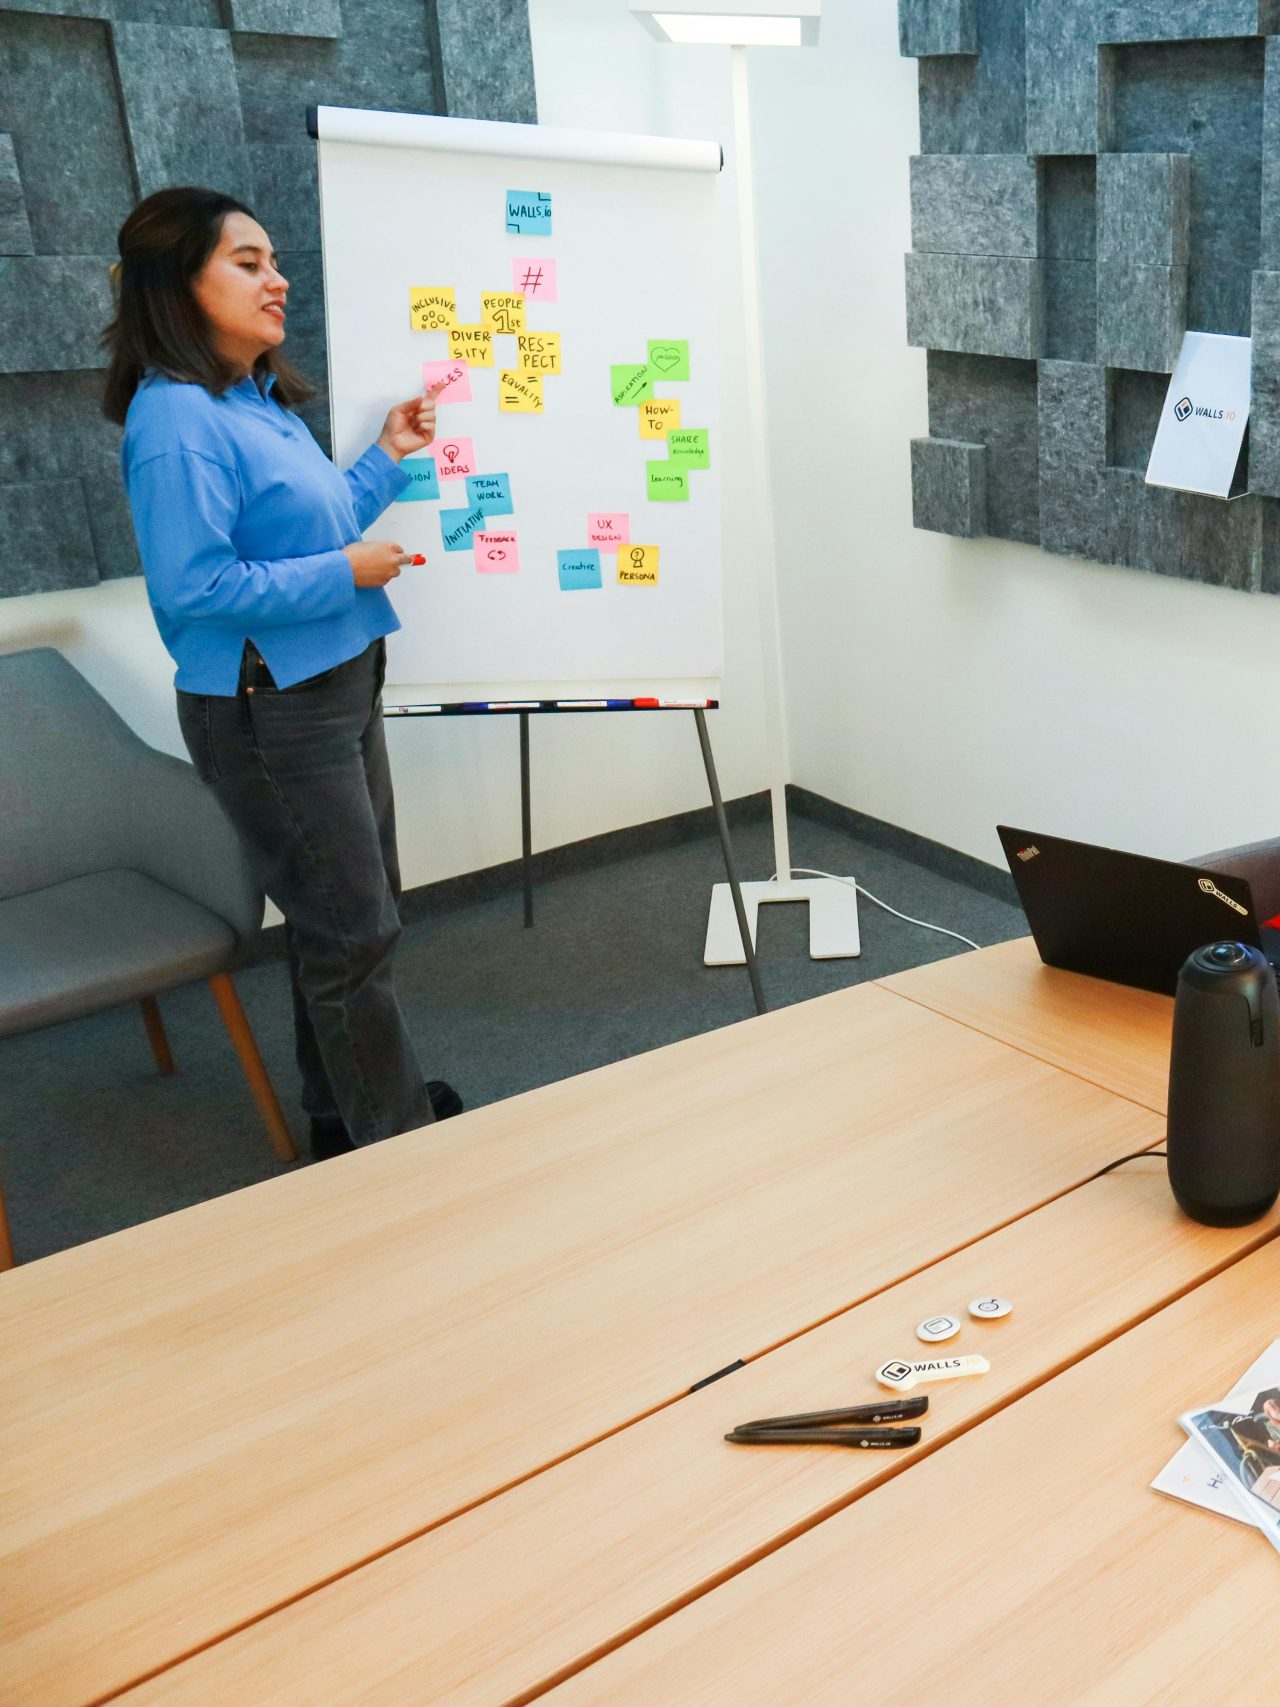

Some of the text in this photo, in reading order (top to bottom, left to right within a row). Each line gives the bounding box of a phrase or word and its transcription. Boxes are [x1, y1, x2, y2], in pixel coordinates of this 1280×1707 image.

[520, 266, 544, 294] #
[411, 296, 457, 313] INCLUSIVE
[483, 297, 523, 310] PEOPLE
[492, 308, 521, 334] 1st
[451, 330, 492, 343] DIVER-
[518, 336, 555, 353] RES-
[453, 347, 488, 360] SITY
[523, 354, 557, 369] PECT
[501, 373, 543, 409] EQUALITY
[614, 365, 648, 404] ASPIRATION
[647, 419, 663, 431] TO
[671, 435, 699, 444] SHARE
[440, 464, 470, 476] IDEAS
[472, 479, 499, 488] TEAM
[477, 491, 505, 501] WORK
[444, 507, 484, 547] INITIATIVE
[597, 519, 613, 530] UX
[620, 570, 656, 581] PERSONA
